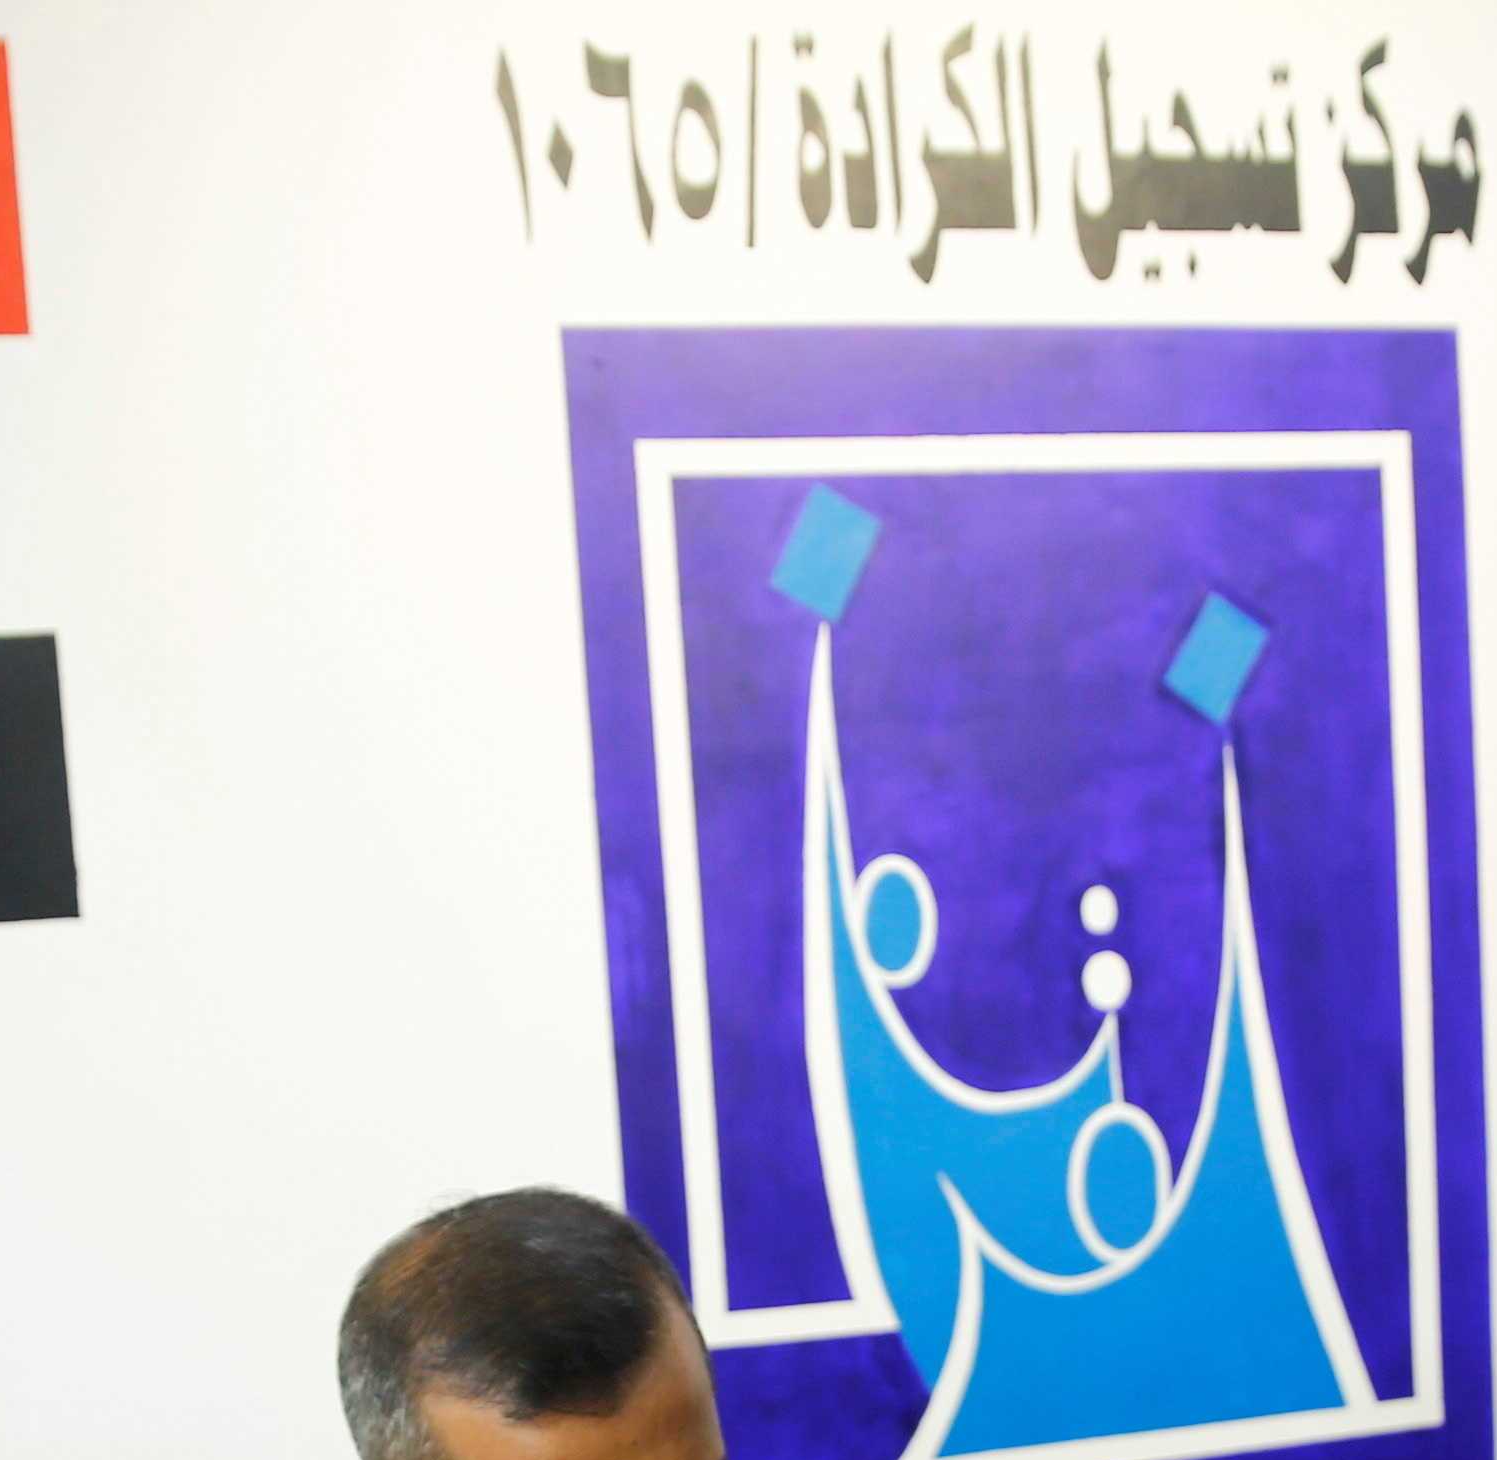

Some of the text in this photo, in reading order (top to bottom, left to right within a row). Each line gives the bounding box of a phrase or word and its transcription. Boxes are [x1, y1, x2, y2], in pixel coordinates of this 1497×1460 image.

[793, 22, 1040, 285] الكرادة
[1072, 36, 1303, 283] تسجيل
[1326, 36, 1481, 285] مركز
